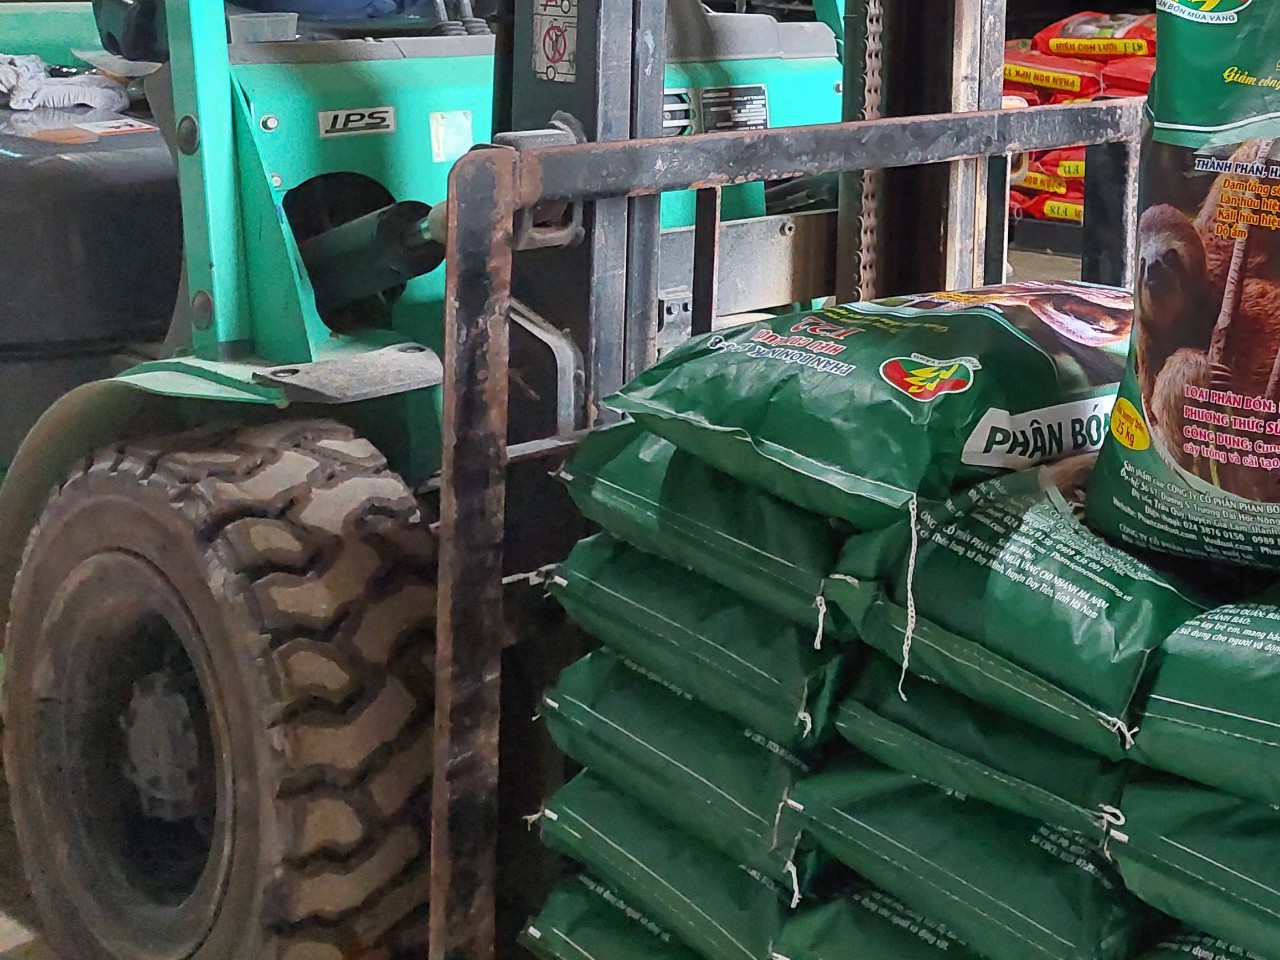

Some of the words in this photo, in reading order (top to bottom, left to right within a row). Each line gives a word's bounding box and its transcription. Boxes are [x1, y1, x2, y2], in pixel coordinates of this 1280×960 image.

[1077, 42, 1096, 52] CON
[1195, 158, 1232, 172] THÀNH
[1184, 385, 1209, 402] LOẠI
[1210, 390, 1242, 409] PHÂN
[1243, 396, 1276, 413] BÓN:
[1231, 416, 1264, 433] THỨC
[982, 419, 1064, 459] PHÂN
[1183, 425, 1215, 442] CÔNG
[1228, 451, 1241, 464] và
[1259, 457, 1280, 470] tạo
[1252, 535, 1276, 545] 0989
[1191, 628, 1213, 641] dụng
[1212, 633, 1227, 643] cho
[1252, 640, 1264, 650] và
[1242, 629, 1267, 640] mang
